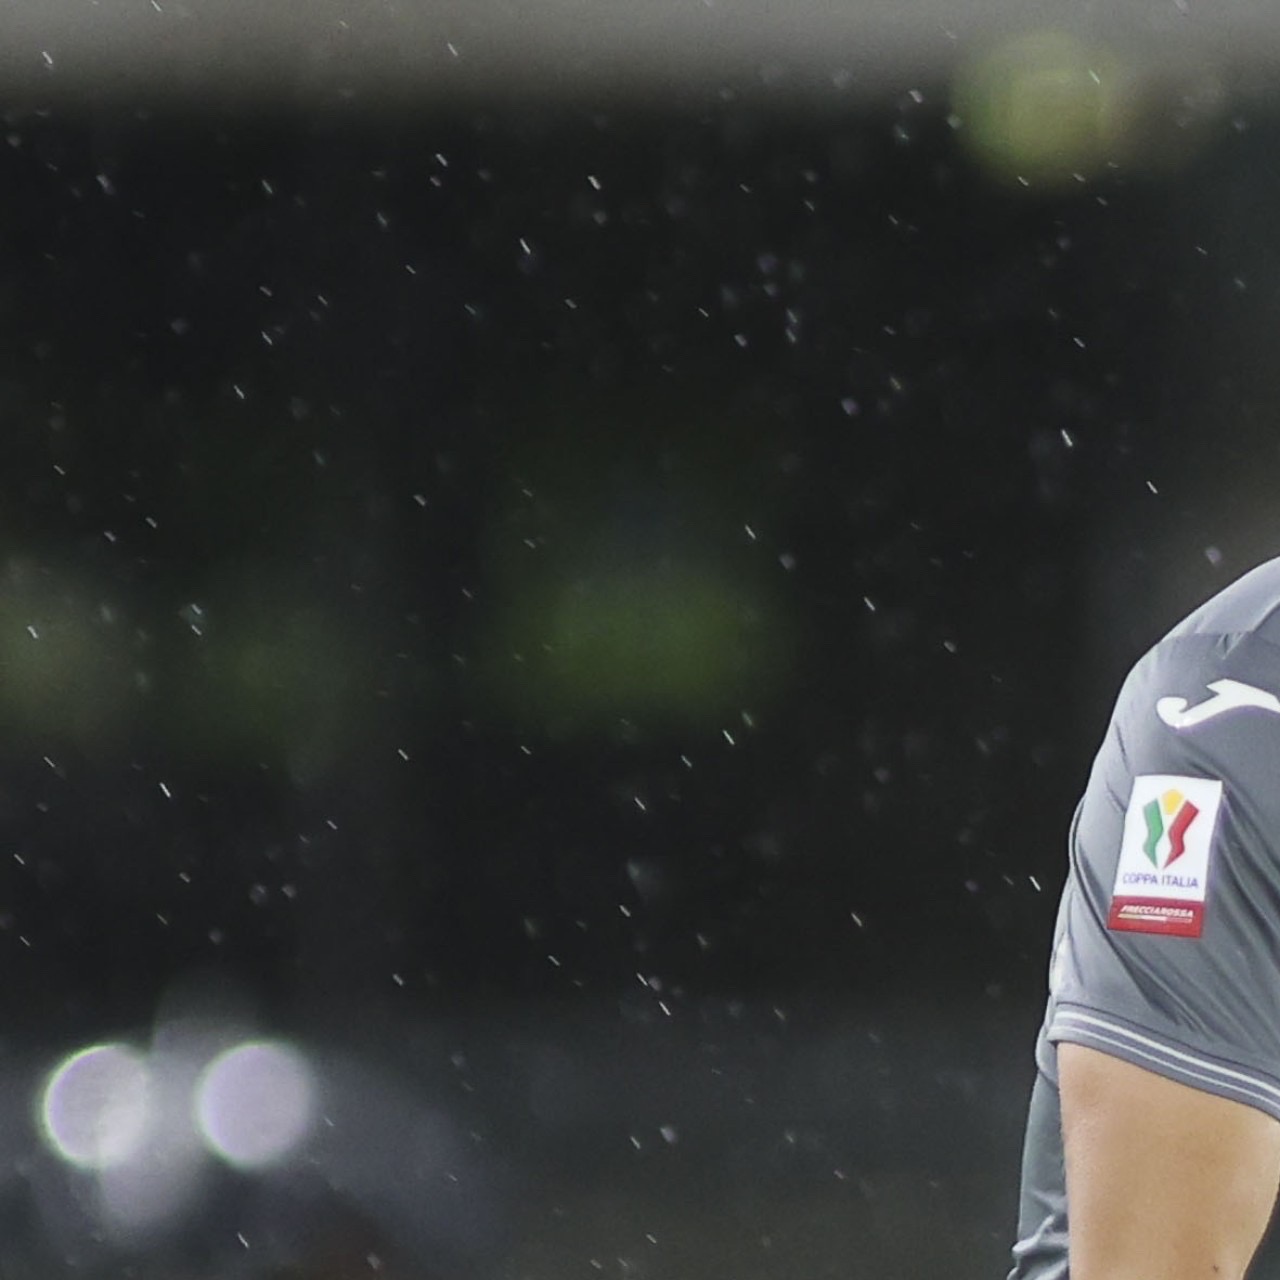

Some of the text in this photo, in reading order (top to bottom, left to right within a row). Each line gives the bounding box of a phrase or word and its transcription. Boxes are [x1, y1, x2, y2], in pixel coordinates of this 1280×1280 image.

[1122, 872, 1199, 888] COPPA ITALIA
[1120, 904, 1194, 918] FRECCIAROSSA
